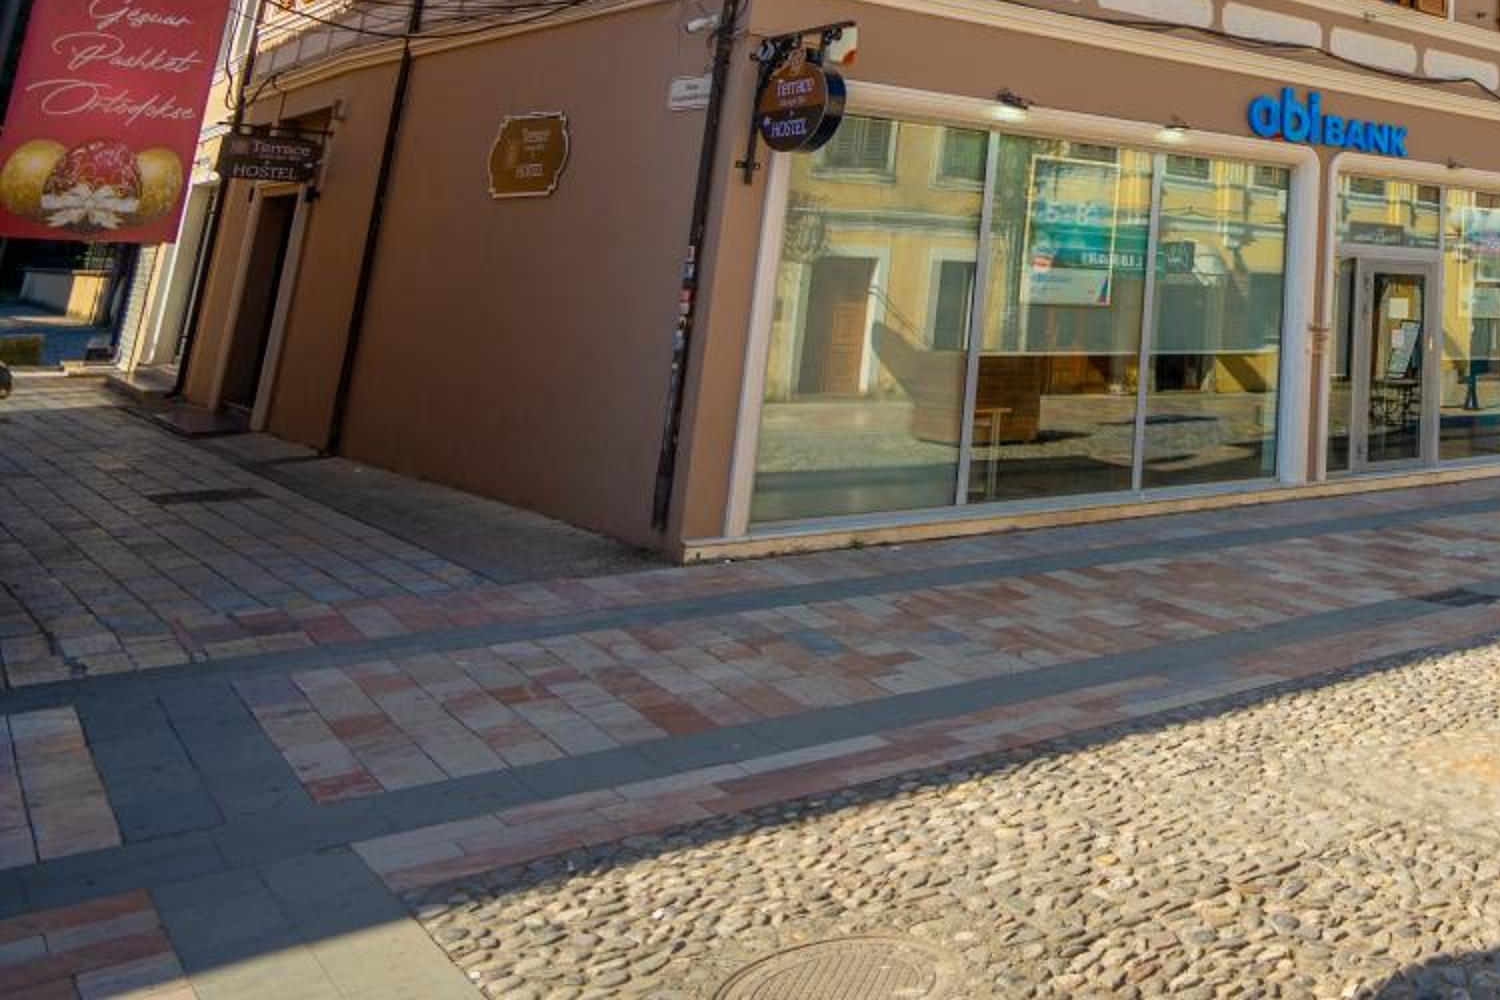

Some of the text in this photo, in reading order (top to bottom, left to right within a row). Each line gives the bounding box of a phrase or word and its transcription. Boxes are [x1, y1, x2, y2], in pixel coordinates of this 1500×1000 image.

[777, 78, 815, 96] Terrace
[771, 119, 806, 137] HOSTEL
[1323, 114, 1408, 157] BANK
[233, 163, 297, 180] HOSTEL
